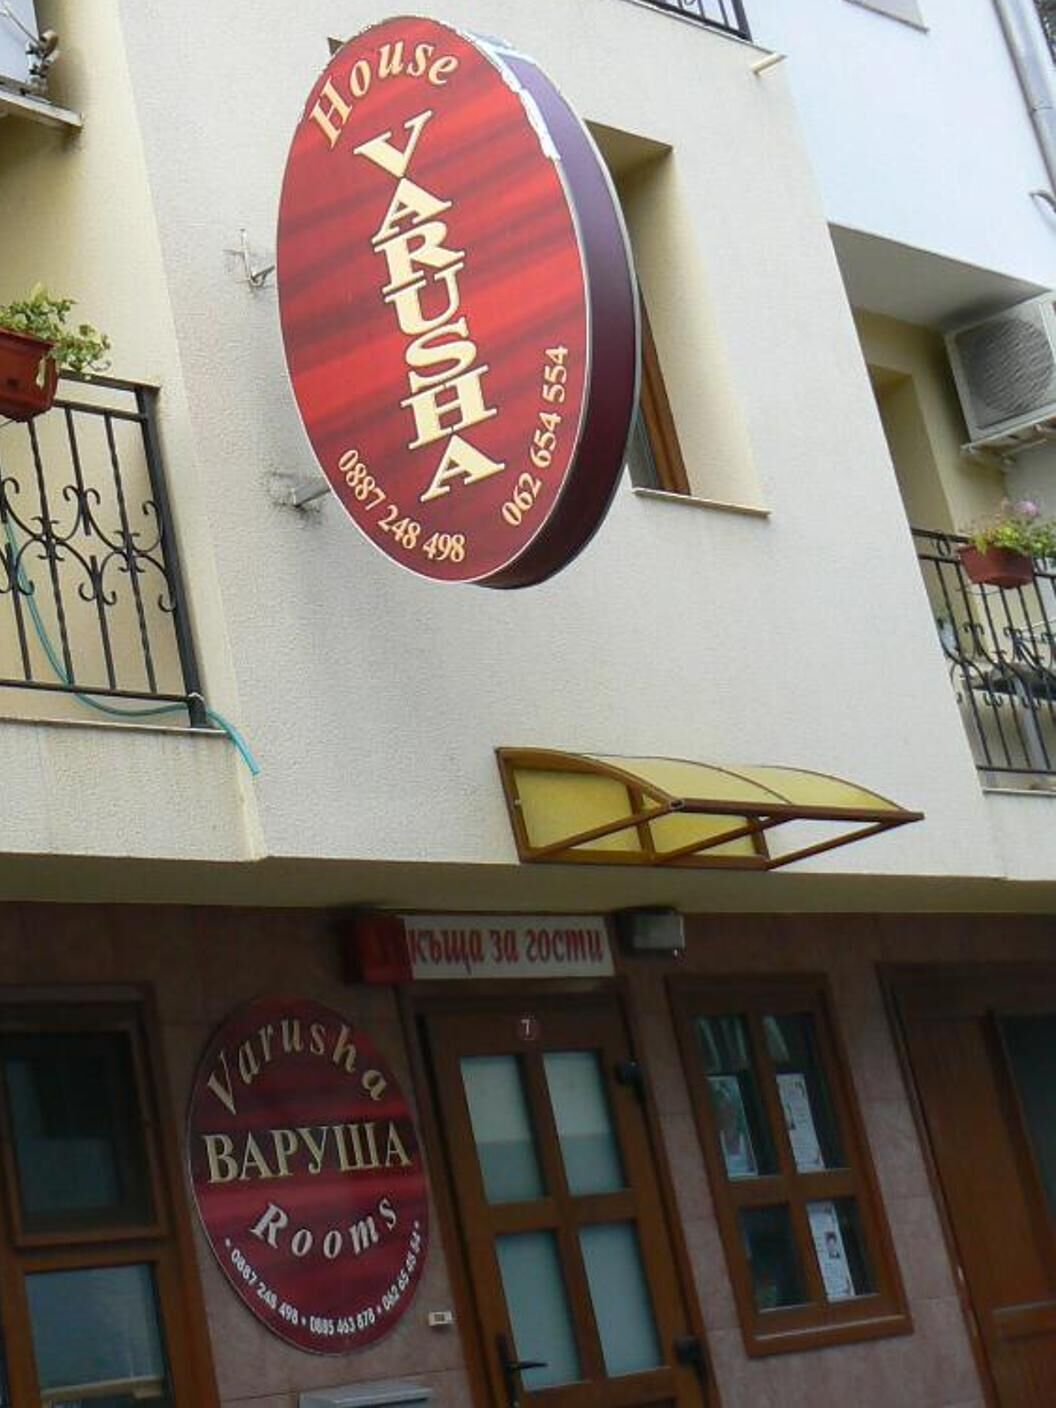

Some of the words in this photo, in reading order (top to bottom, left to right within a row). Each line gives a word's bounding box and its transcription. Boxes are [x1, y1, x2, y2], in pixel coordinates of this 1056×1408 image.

[309, 39, 458, 146] House
[354, 110, 505, 503] VARUSHA
[542, 345, 569, 403] 554
[530, 412, 561, 468] 654
[338, 449, 386, 510] 0887
[378, 505, 421, 549] 248
[423, 533, 465, 562] 498
[502, 472, 542, 526] 062
[490, 929, 520, 963] за
[526, 928, 604, 963] гости
[207, 1017, 388, 1116] Varusha
[202, 1122, 412, 1184] ВАРУША
[251, 1197, 397, 1259] Rooms
[231, 1249, 257, 1285] 0887
[279, 1302, 298, 1325] 498
